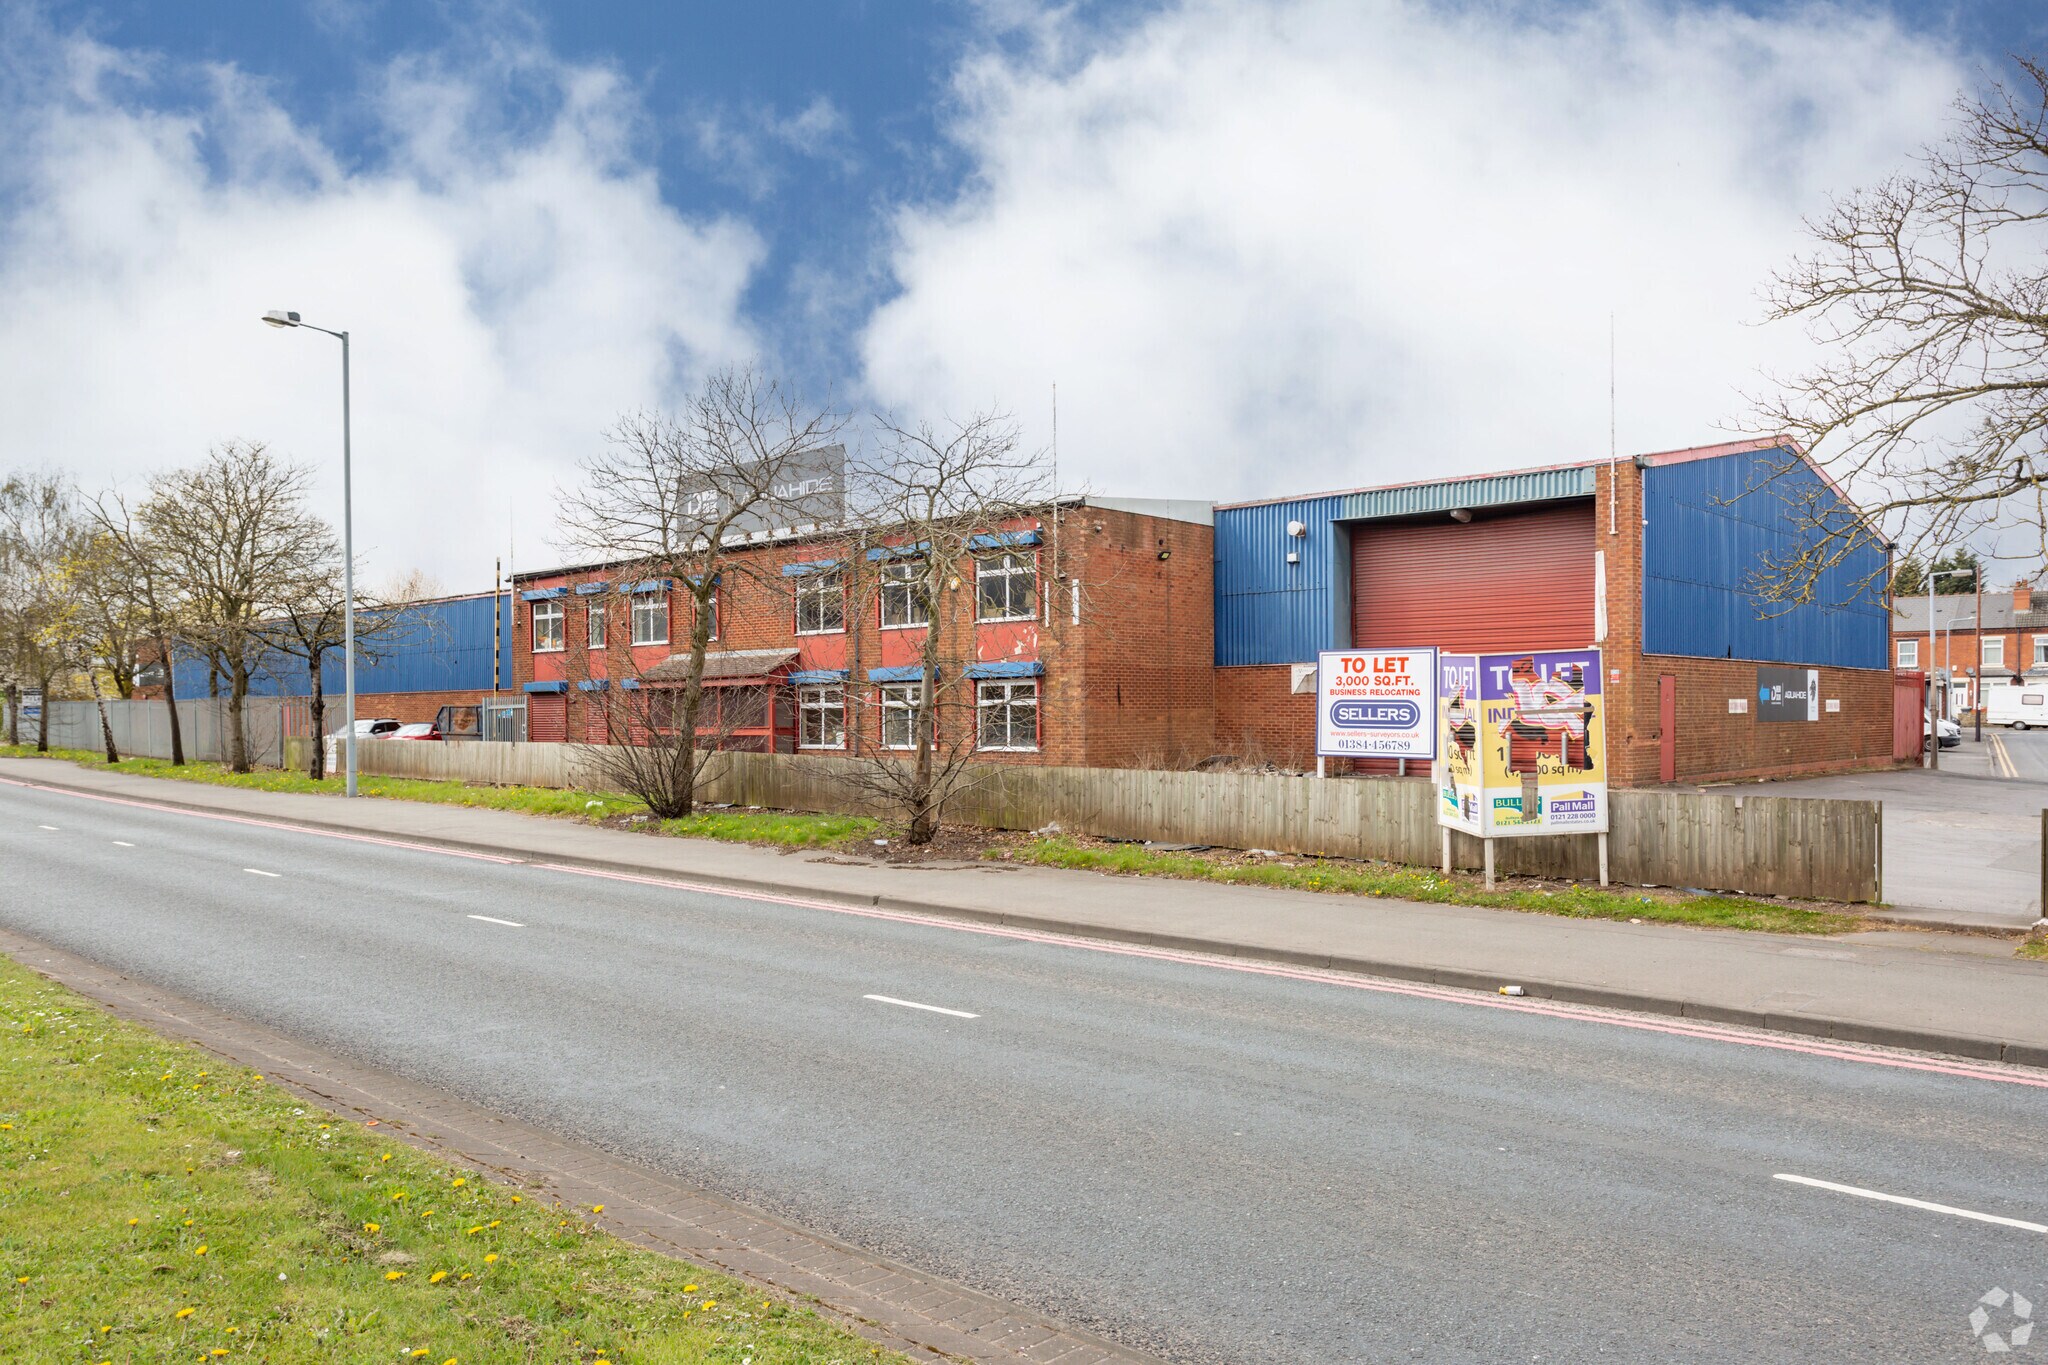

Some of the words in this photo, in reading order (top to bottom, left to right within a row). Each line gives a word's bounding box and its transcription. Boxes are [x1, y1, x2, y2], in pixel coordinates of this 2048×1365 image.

[1341, 657, 1366, 673] TO
[1373, 657, 1409, 673] LET
[1335, 675, 1369, 688] 3,000
[1374, 675, 1414, 686] SQ.FT.
[1338, 707, 1410, 721] SELLERS
[1330, 730, 1420, 739] www.sellers-surveyors.co.uk
[1552, 763, 1565, 776] sq
[1552, 802, 1570, 811] Pall
[1572, 800, 1593, 810] Mall
